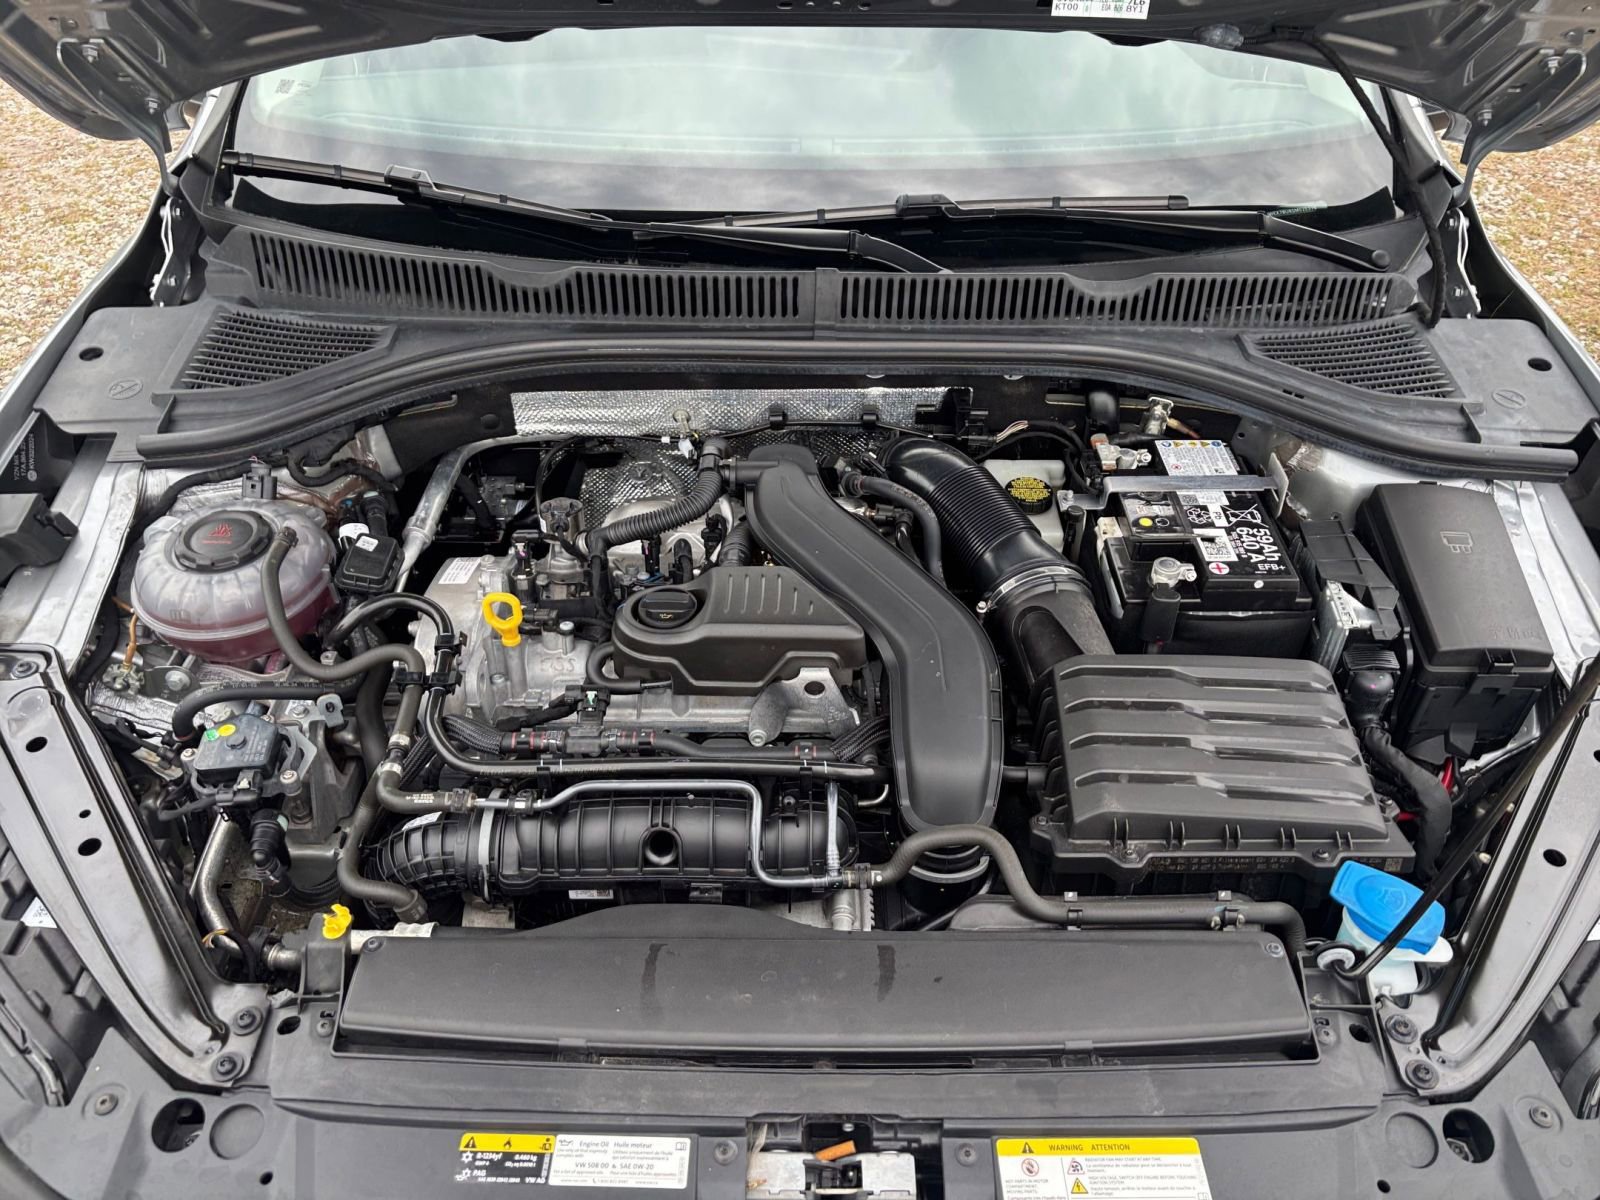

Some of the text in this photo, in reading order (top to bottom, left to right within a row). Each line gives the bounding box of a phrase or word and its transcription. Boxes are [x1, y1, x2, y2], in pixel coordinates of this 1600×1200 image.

[1236, 527, 1260, 550] 640
[1253, 528, 1282, 561] 59Ah
[1247, 553, 1266, 563] A
[1257, 563, 1286, 571] EFB+
[1048, 1143, 1130, 1151] WARNING ATTENTION
